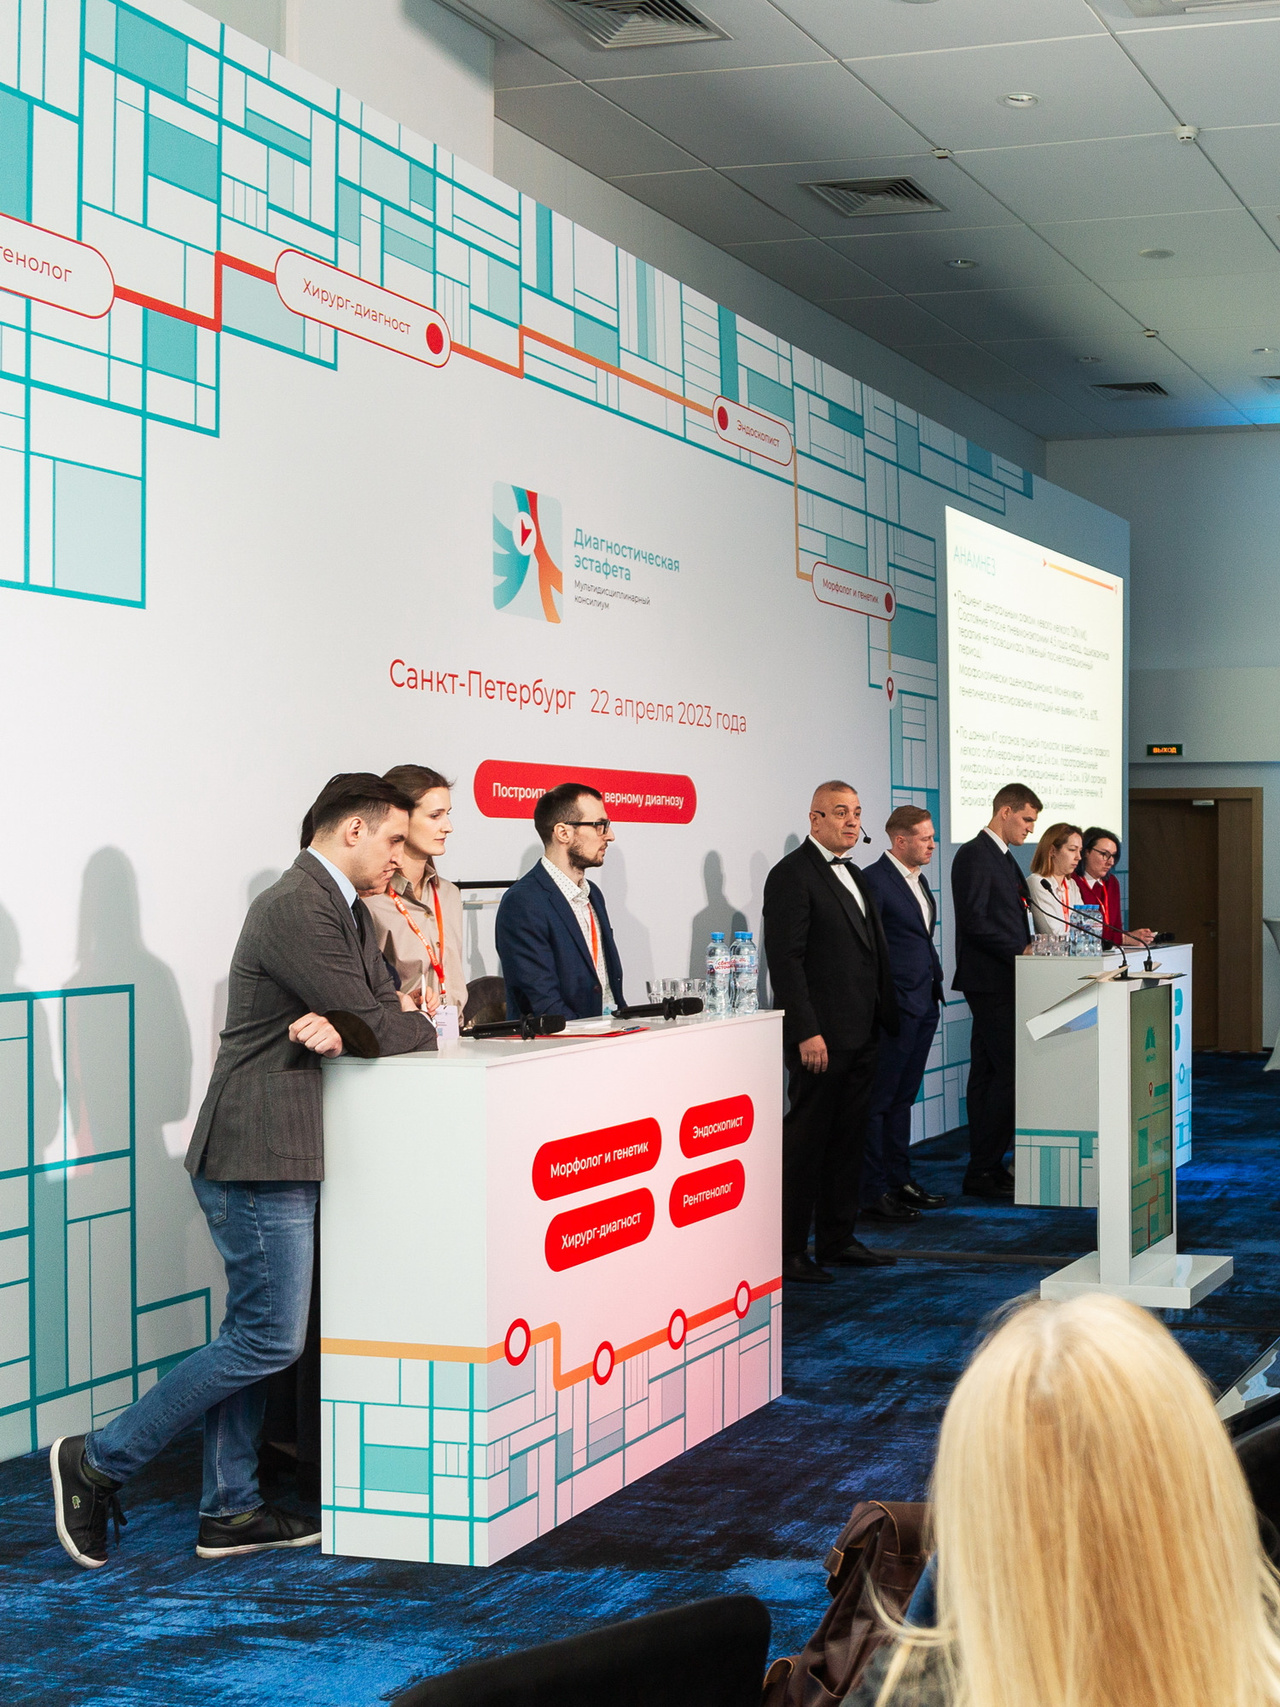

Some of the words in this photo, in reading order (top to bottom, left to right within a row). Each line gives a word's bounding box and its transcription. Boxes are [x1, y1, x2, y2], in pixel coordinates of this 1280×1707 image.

[0, 246, 72, 282] енолог
[303, 278, 411, 335] Хирург-диагност
[736, 419, 780, 448] Эндоскопист
[574, 527, 680, 572] Диагностическая
[952, 545, 995, 576] АНАМНЕЗ
[574, 554, 631, 581] эстафета
[574, 580, 650, 606] Мультидисциплинарный
[574, 595, 610, 611] консилиум
[822, 578, 852, 598] Морфолог
[858, 590, 879, 604] генетик
[389, 658, 576, 715] Санкт-Петербург
[590, 688, 610, 715] 22
[614, 697, 674, 724] апреля
[678, 701, 712, 728] 2023
[716, 711, 748, 735] года
[492, 782, 546, 802] Построит
[604, 792, 643, 808] верному
[645, 794, 684, 810] диагнозу
[692, 1116, 744, 1139] Эндоскопист
[550, 1154, 603, 1179] Морфолог
[604, 1151, 610, 1164] и
[612, 1141, 649, 1162] генетик
[682, 1182, 733, 1208] Рентгенолог
[561, 1212, 642, 1250] Хирург-диагност
